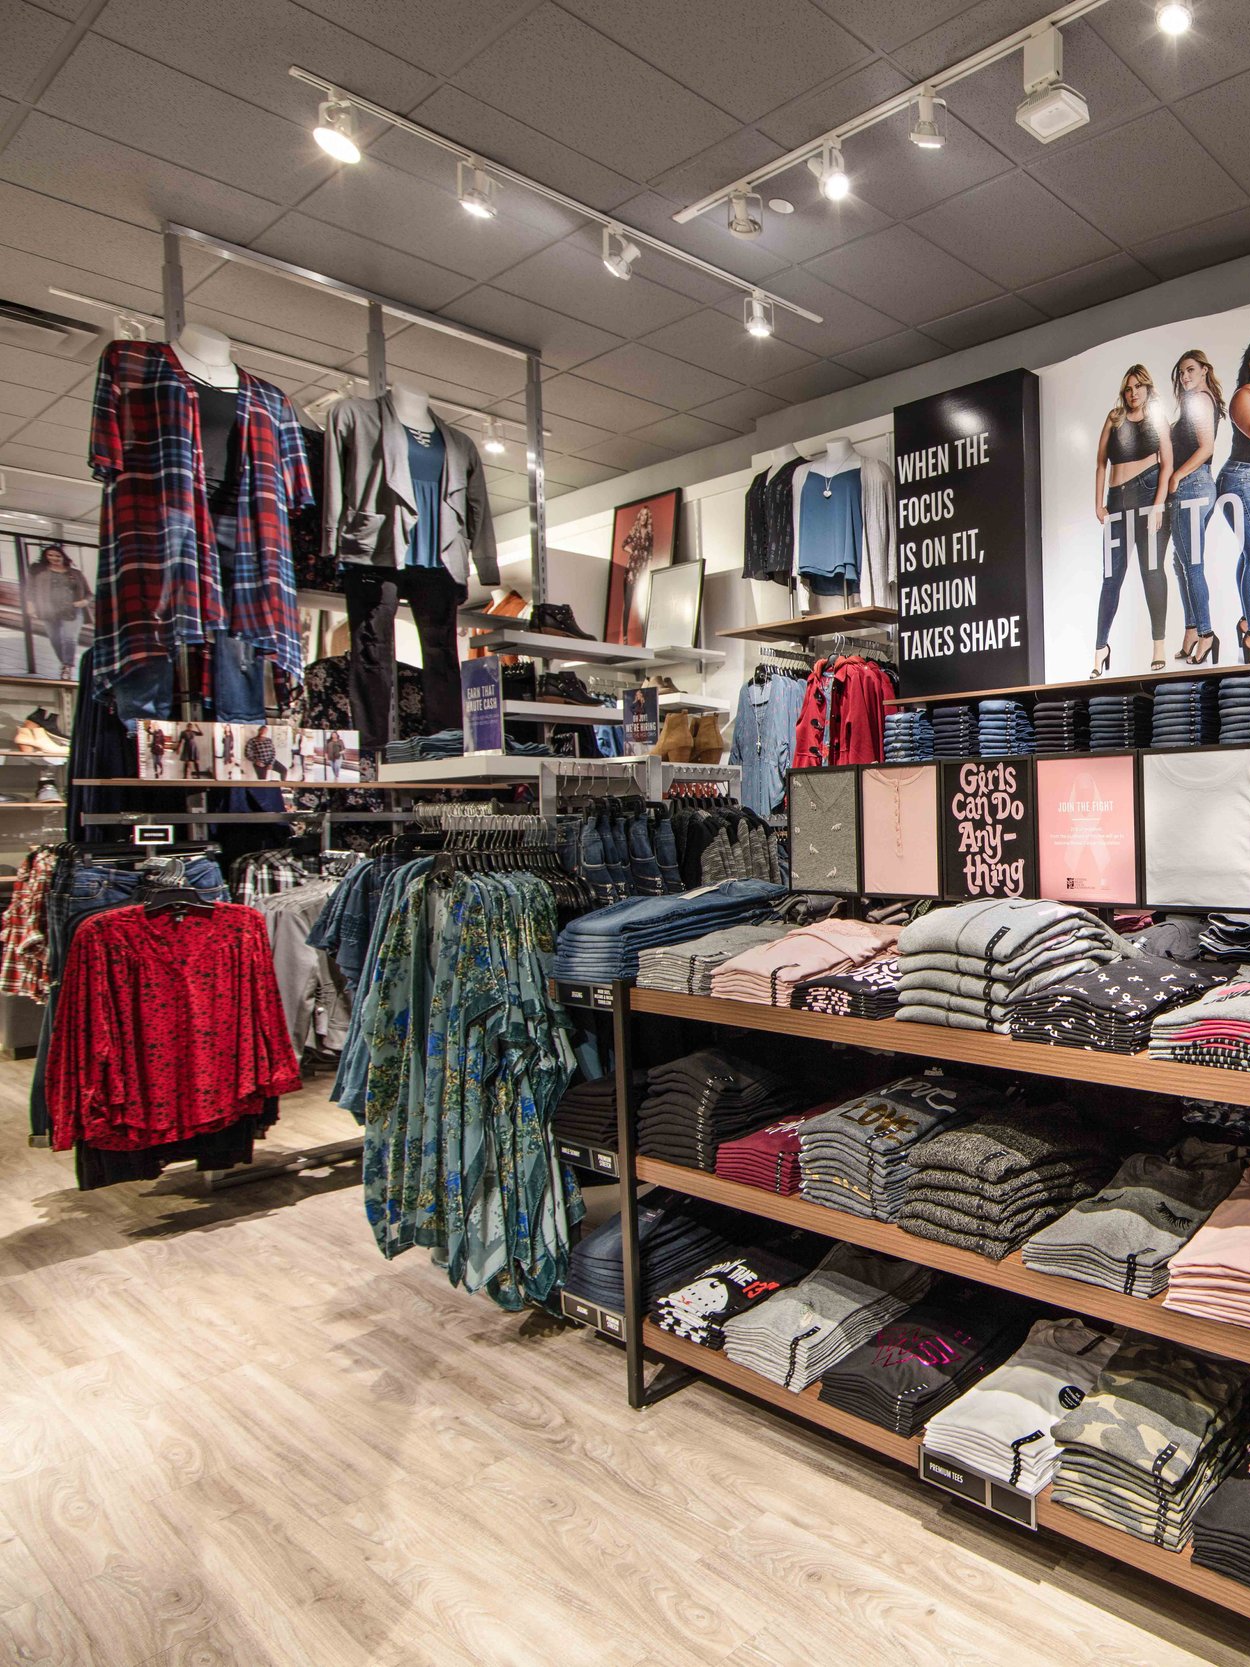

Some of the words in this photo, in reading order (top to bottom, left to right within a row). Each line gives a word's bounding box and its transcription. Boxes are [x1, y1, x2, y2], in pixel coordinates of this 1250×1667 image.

[897, 445, 949, 485] WHEN
[955, 432, 990, 470] THE
[899, 488, 955, 529] FOCUS
[900, 543, 917, 573] IS
[922, 535, 947, 569] ON
[952, 528, 985, 564] FIT,
[1103, 504, 1167, 578] FIT
[1178, 492, 1245, 566] TO
[901, 576, 977, 617] FASHION
[901, 622, 955, 661] TAKES
[960, 615, 1021, 654] SHAPE
[960, 763, 1016, 795] Girls
[996, 792, 1025, 820] Do
[1058, 801, 1074, 812] JOIN
[1077, 801, 1090, 812] THE
[1092, 800, 1113, 811] FIGHT
[963, 854, 1025, 897] thing
[929, 1462, 952, 1479] PREMIUM
[952, 1471, 964, 1484] TEES
